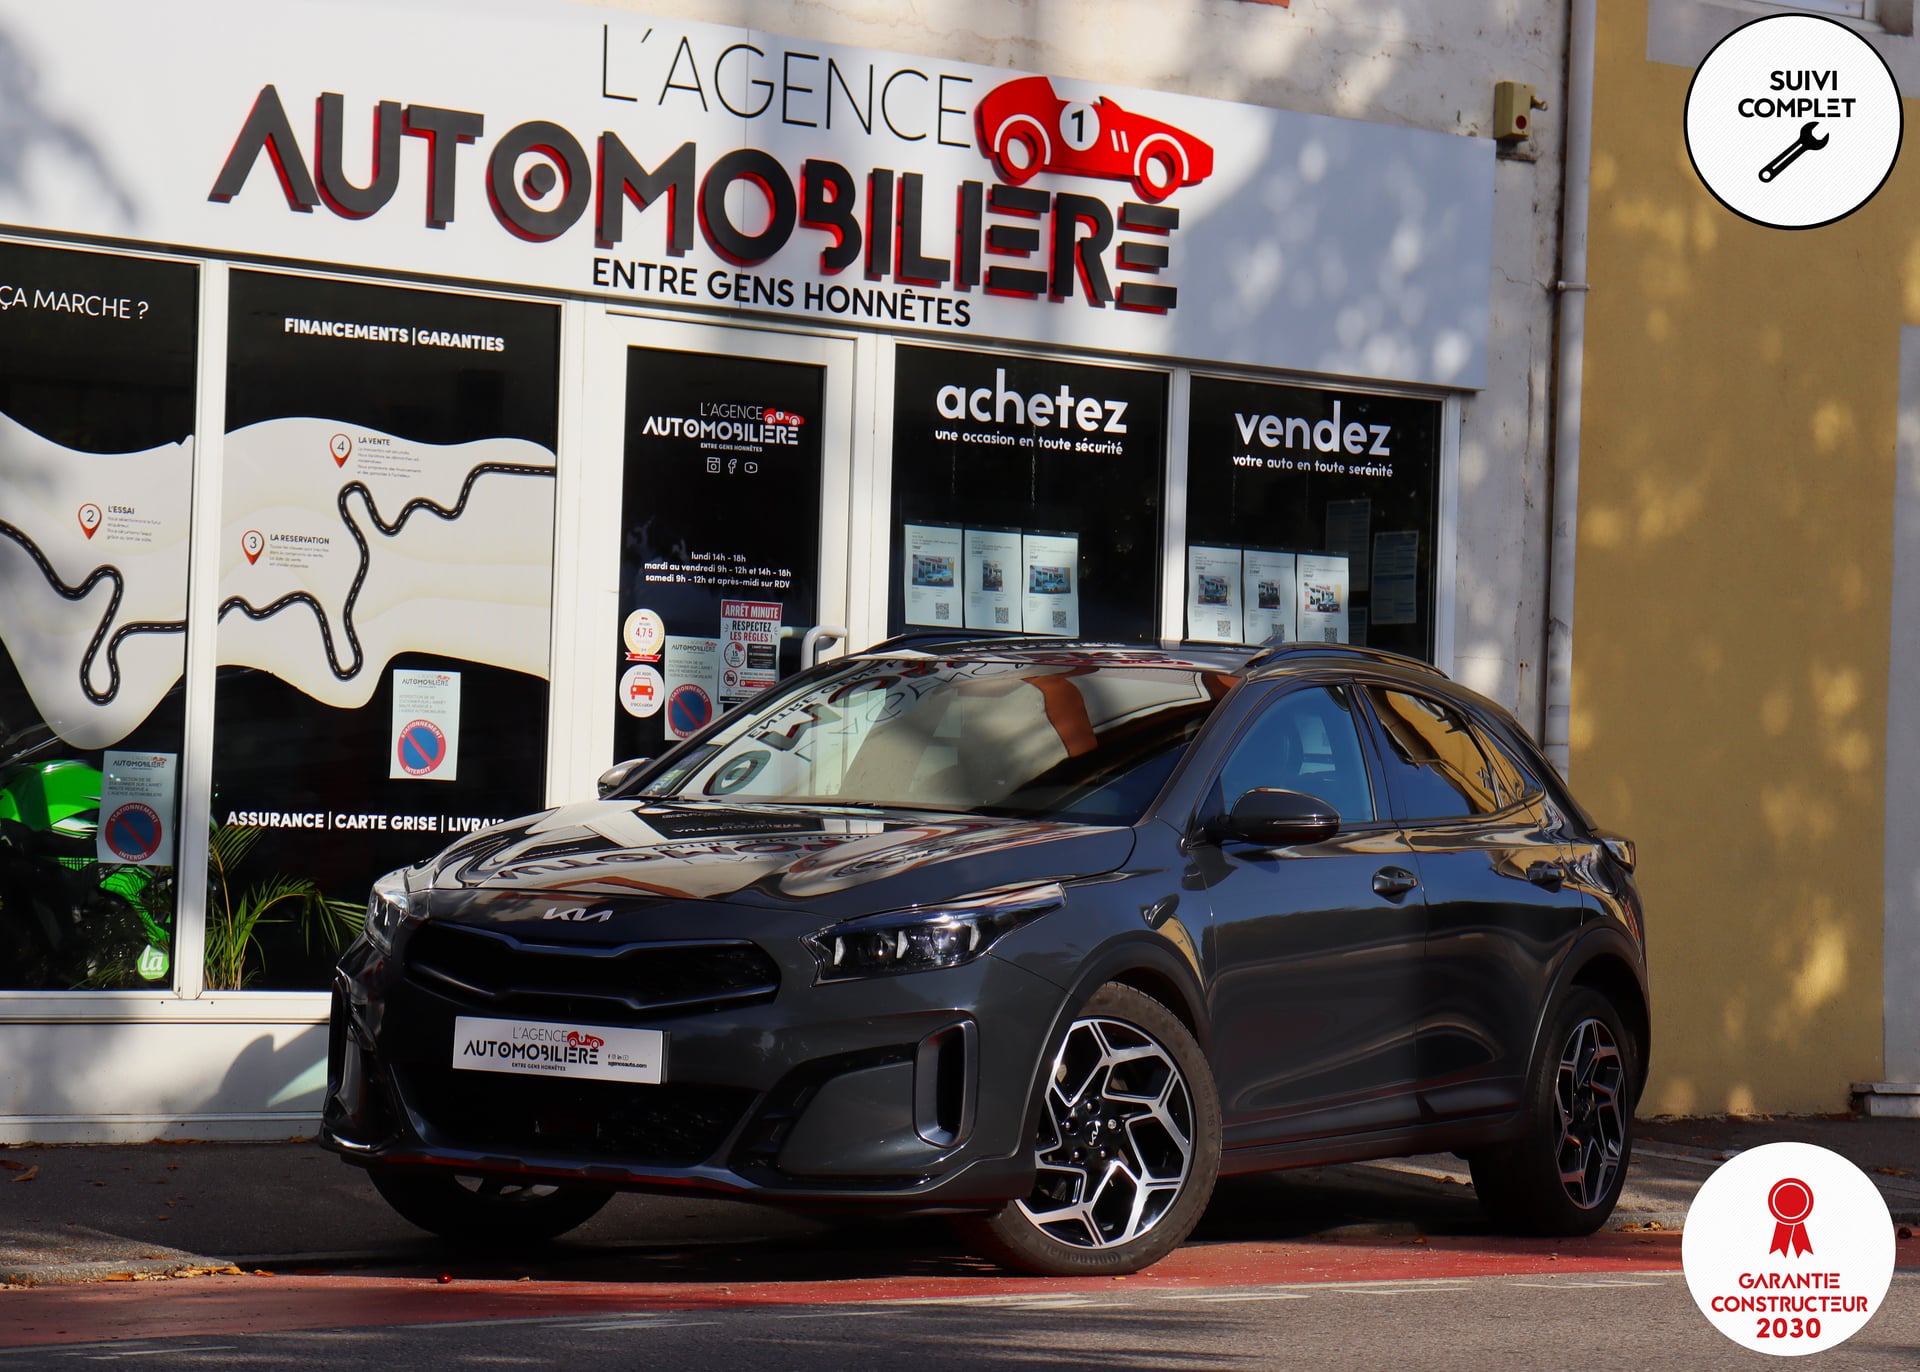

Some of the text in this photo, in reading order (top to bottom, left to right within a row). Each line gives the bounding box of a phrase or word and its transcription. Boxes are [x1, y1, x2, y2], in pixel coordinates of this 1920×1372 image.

[1070, 110, 1085, 142] 1
[207, 84, 1180, 315] AUTOMOBILIERE
[592, 257, 972, 327] ENTRE GENS HONNÊTES
[33, 289, 132, 320] MARCHE
[137, 300, 149, 320] ?
[284, 317, 505, 352] FINANCEMENTS GARANTIES
[936, 367, 1129, 434] achetez
[642, 415, 799, 445] AUTOMOBILIERE
[1234, 400, 1392, 456] vendez
[336, 441, 346, 452] 4
[368, 438, 391, 446] VENTE
[935, 430, 1123, 456] une occasion en toute sécurité
[1232, 455, 1263, 468] votre
[1266, 458, 1294, 470] auto
[1297, 461, 1311, 472] en
[1314, 460, 1345, 474] toute
[86, 509, 95, 523] 2
[249, 536, 257, 549] 3
[691, 552, 711, 561] lundi
[712, 553, 726, 562] 14h
[733, 554, 746, 563] 18h
[644, 562, 668, 570] mardi
[681, 564, 716, 573] vendredi
[717, 565, 727, 573] 9h
[735, 566, 747, 574] 12h
[758, 568, 771, 576] 14h
[778, 569, 792, 577] 18h
[645, 574, 675, 583] samedi
[675, 575, 686, 583] 9h
[693, 576, 706, 584] 12h
[717, 577, 759, 587] après-midi
[774, 580, 790, 589] RDV
[725, 603, 778, 619] ARRÊT MINUTE
[732, 620, 772, 633] RESPECTEZ
[730, 632, 742, 641] LES
[405, 766, 431, 775] INTERDIT
[110, 803, 159, 823] STATIONNEMENT
[226, 811, 324, 829] ASSURANCE
[334, 813, 387, 830] CARTE
[390, 815, 437, 831] GRISE
[119, 850, 148, 862] INTERDIT
[542, 907, 614, 923] KIA
[463, 1039, 599, 1065] AUTOMOBILIERE
